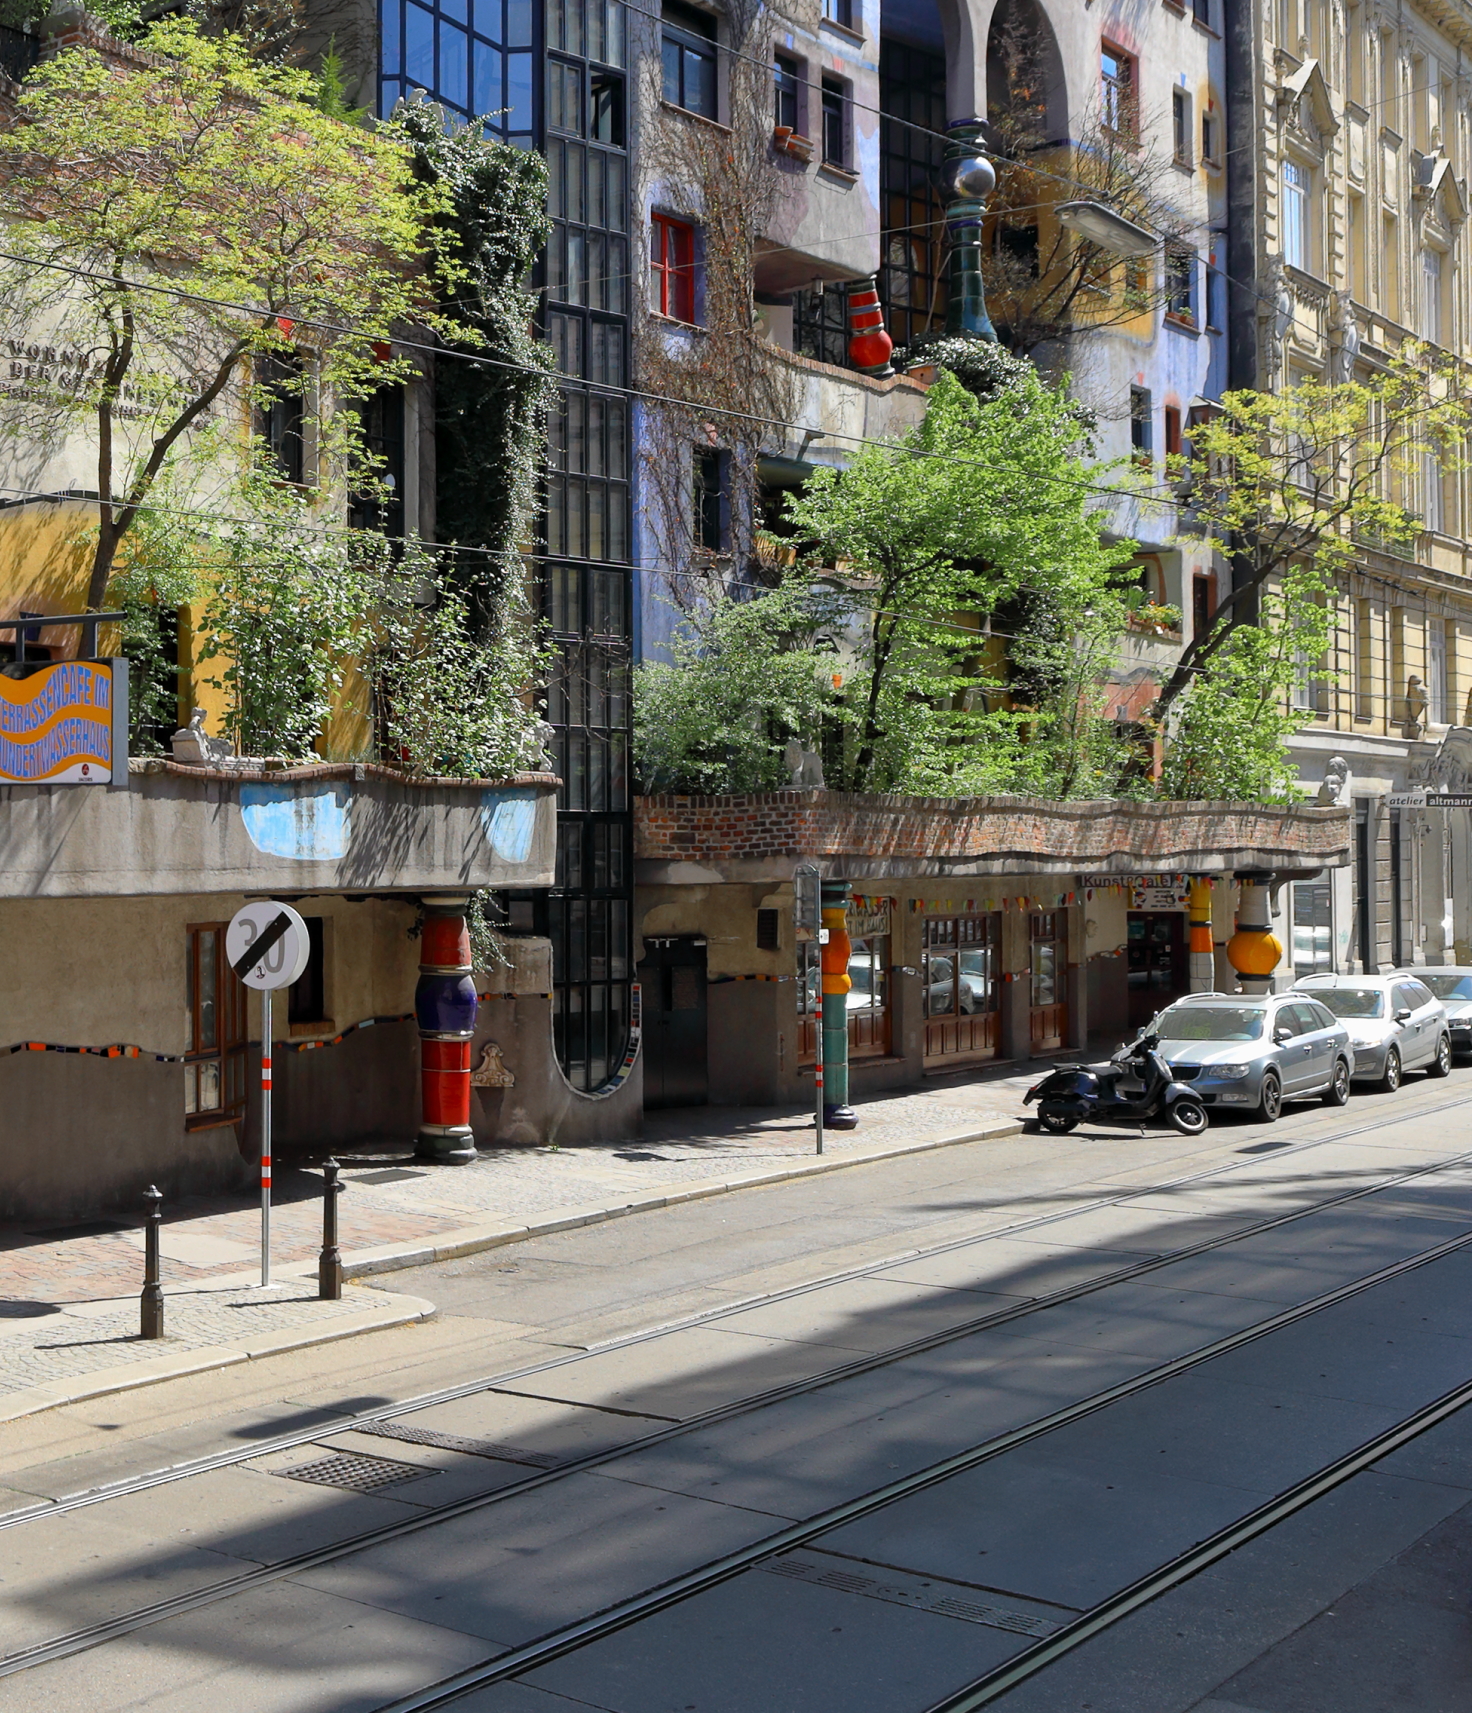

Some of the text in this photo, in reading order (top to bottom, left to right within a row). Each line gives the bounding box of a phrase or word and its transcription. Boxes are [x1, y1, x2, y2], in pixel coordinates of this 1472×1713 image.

[10, 360, 51, 382] DER
[94, 674, 110, 709] IM
[1389, 796, 1424, 805] atelier
